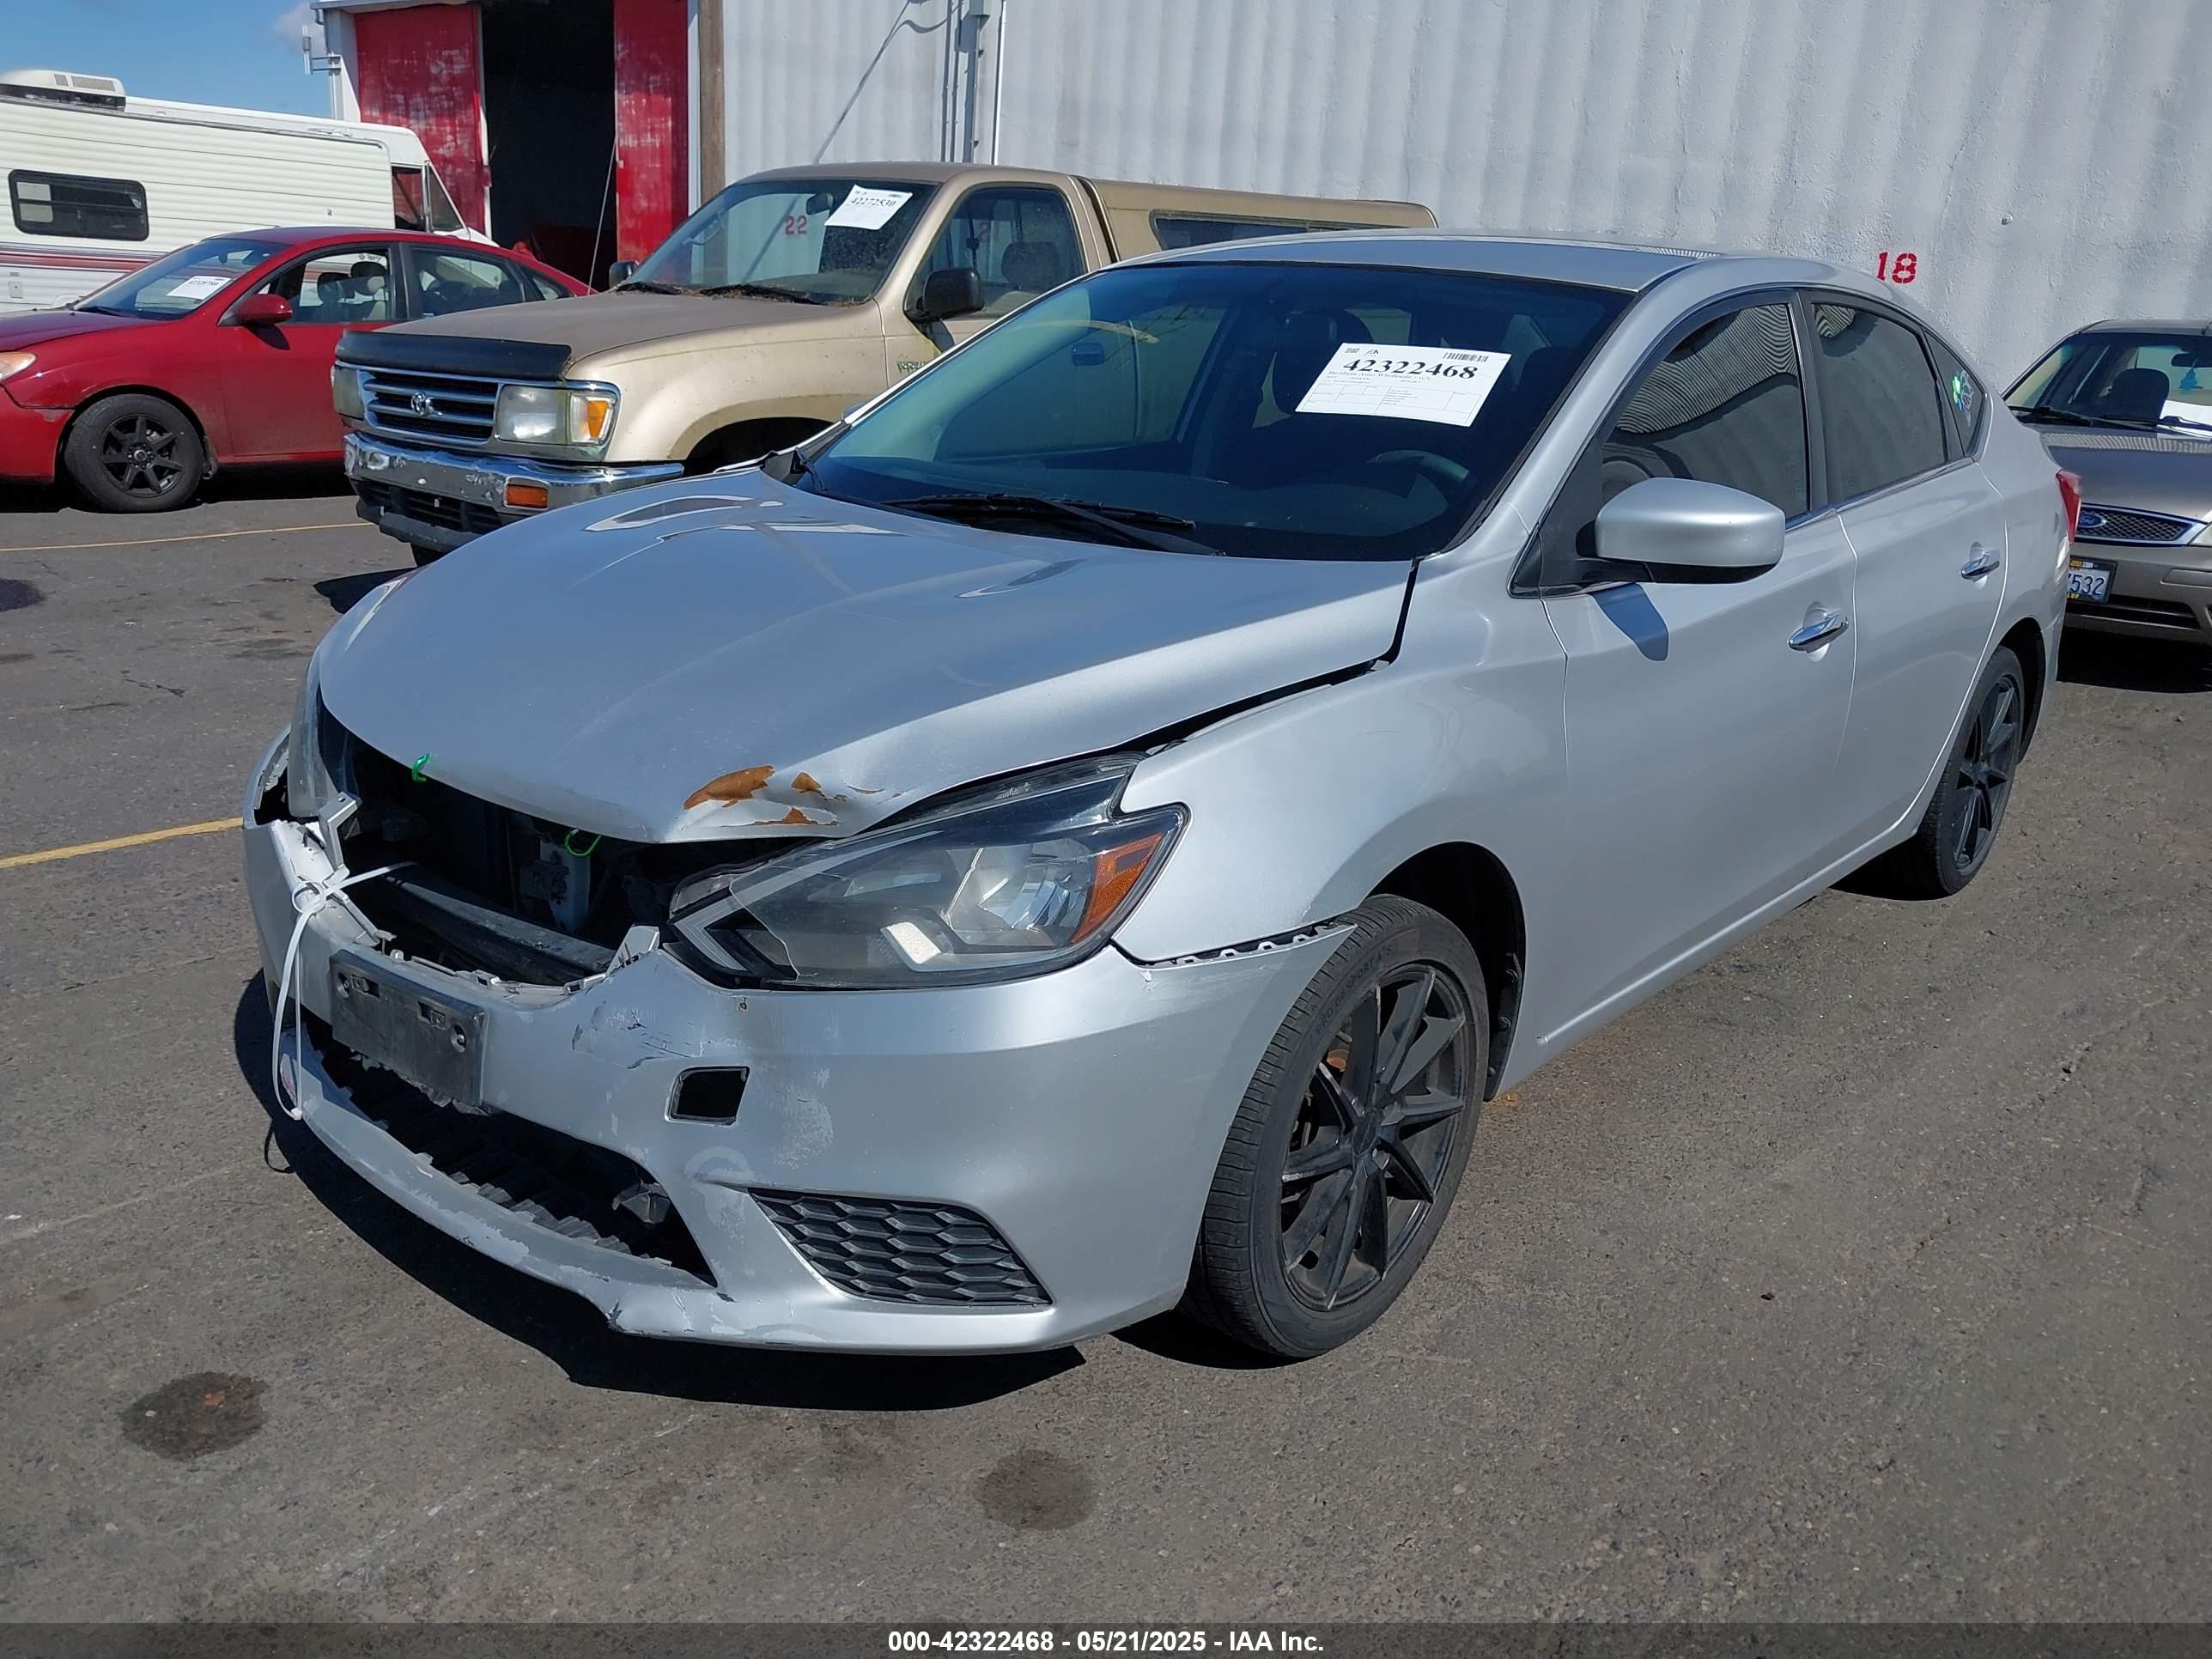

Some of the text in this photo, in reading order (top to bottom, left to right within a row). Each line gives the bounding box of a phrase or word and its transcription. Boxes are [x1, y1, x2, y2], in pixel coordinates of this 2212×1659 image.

[785, 215, 808, 234] 22
[1876, 252, 1917, 284] 18
[1342, 359, 1478, 380] 42322468
[2067, 571, 2106, 596] 532
